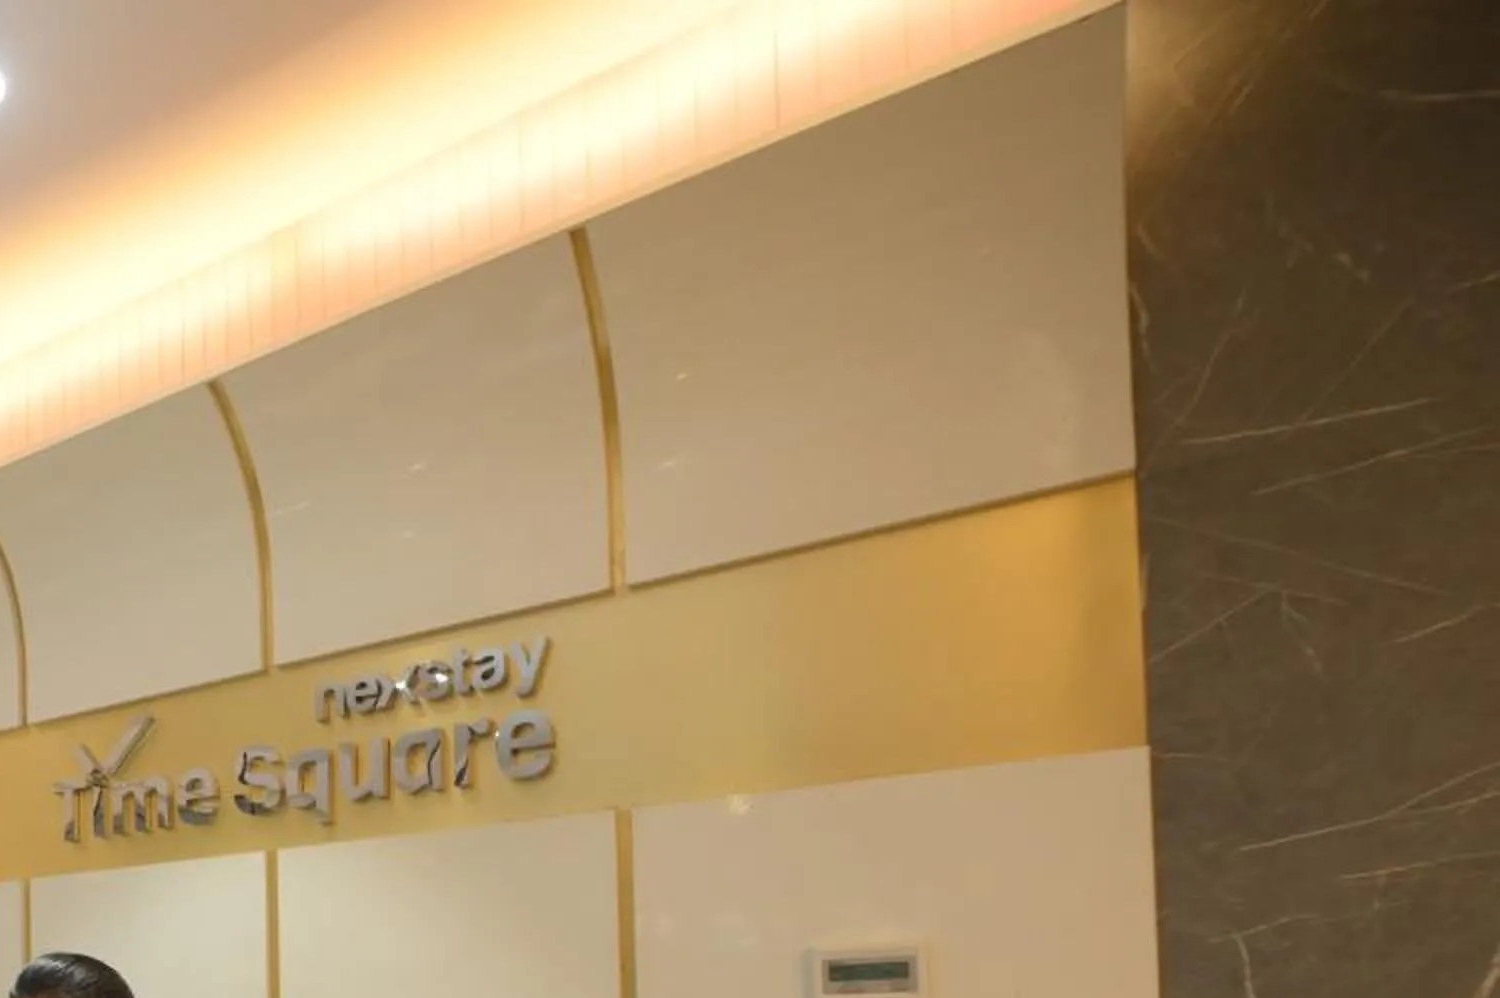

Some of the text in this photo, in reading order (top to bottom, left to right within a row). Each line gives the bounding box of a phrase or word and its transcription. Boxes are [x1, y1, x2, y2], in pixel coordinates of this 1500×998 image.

[315, 635, 550, 723] nexstay
[53, 709, 557, 843] Time Square
